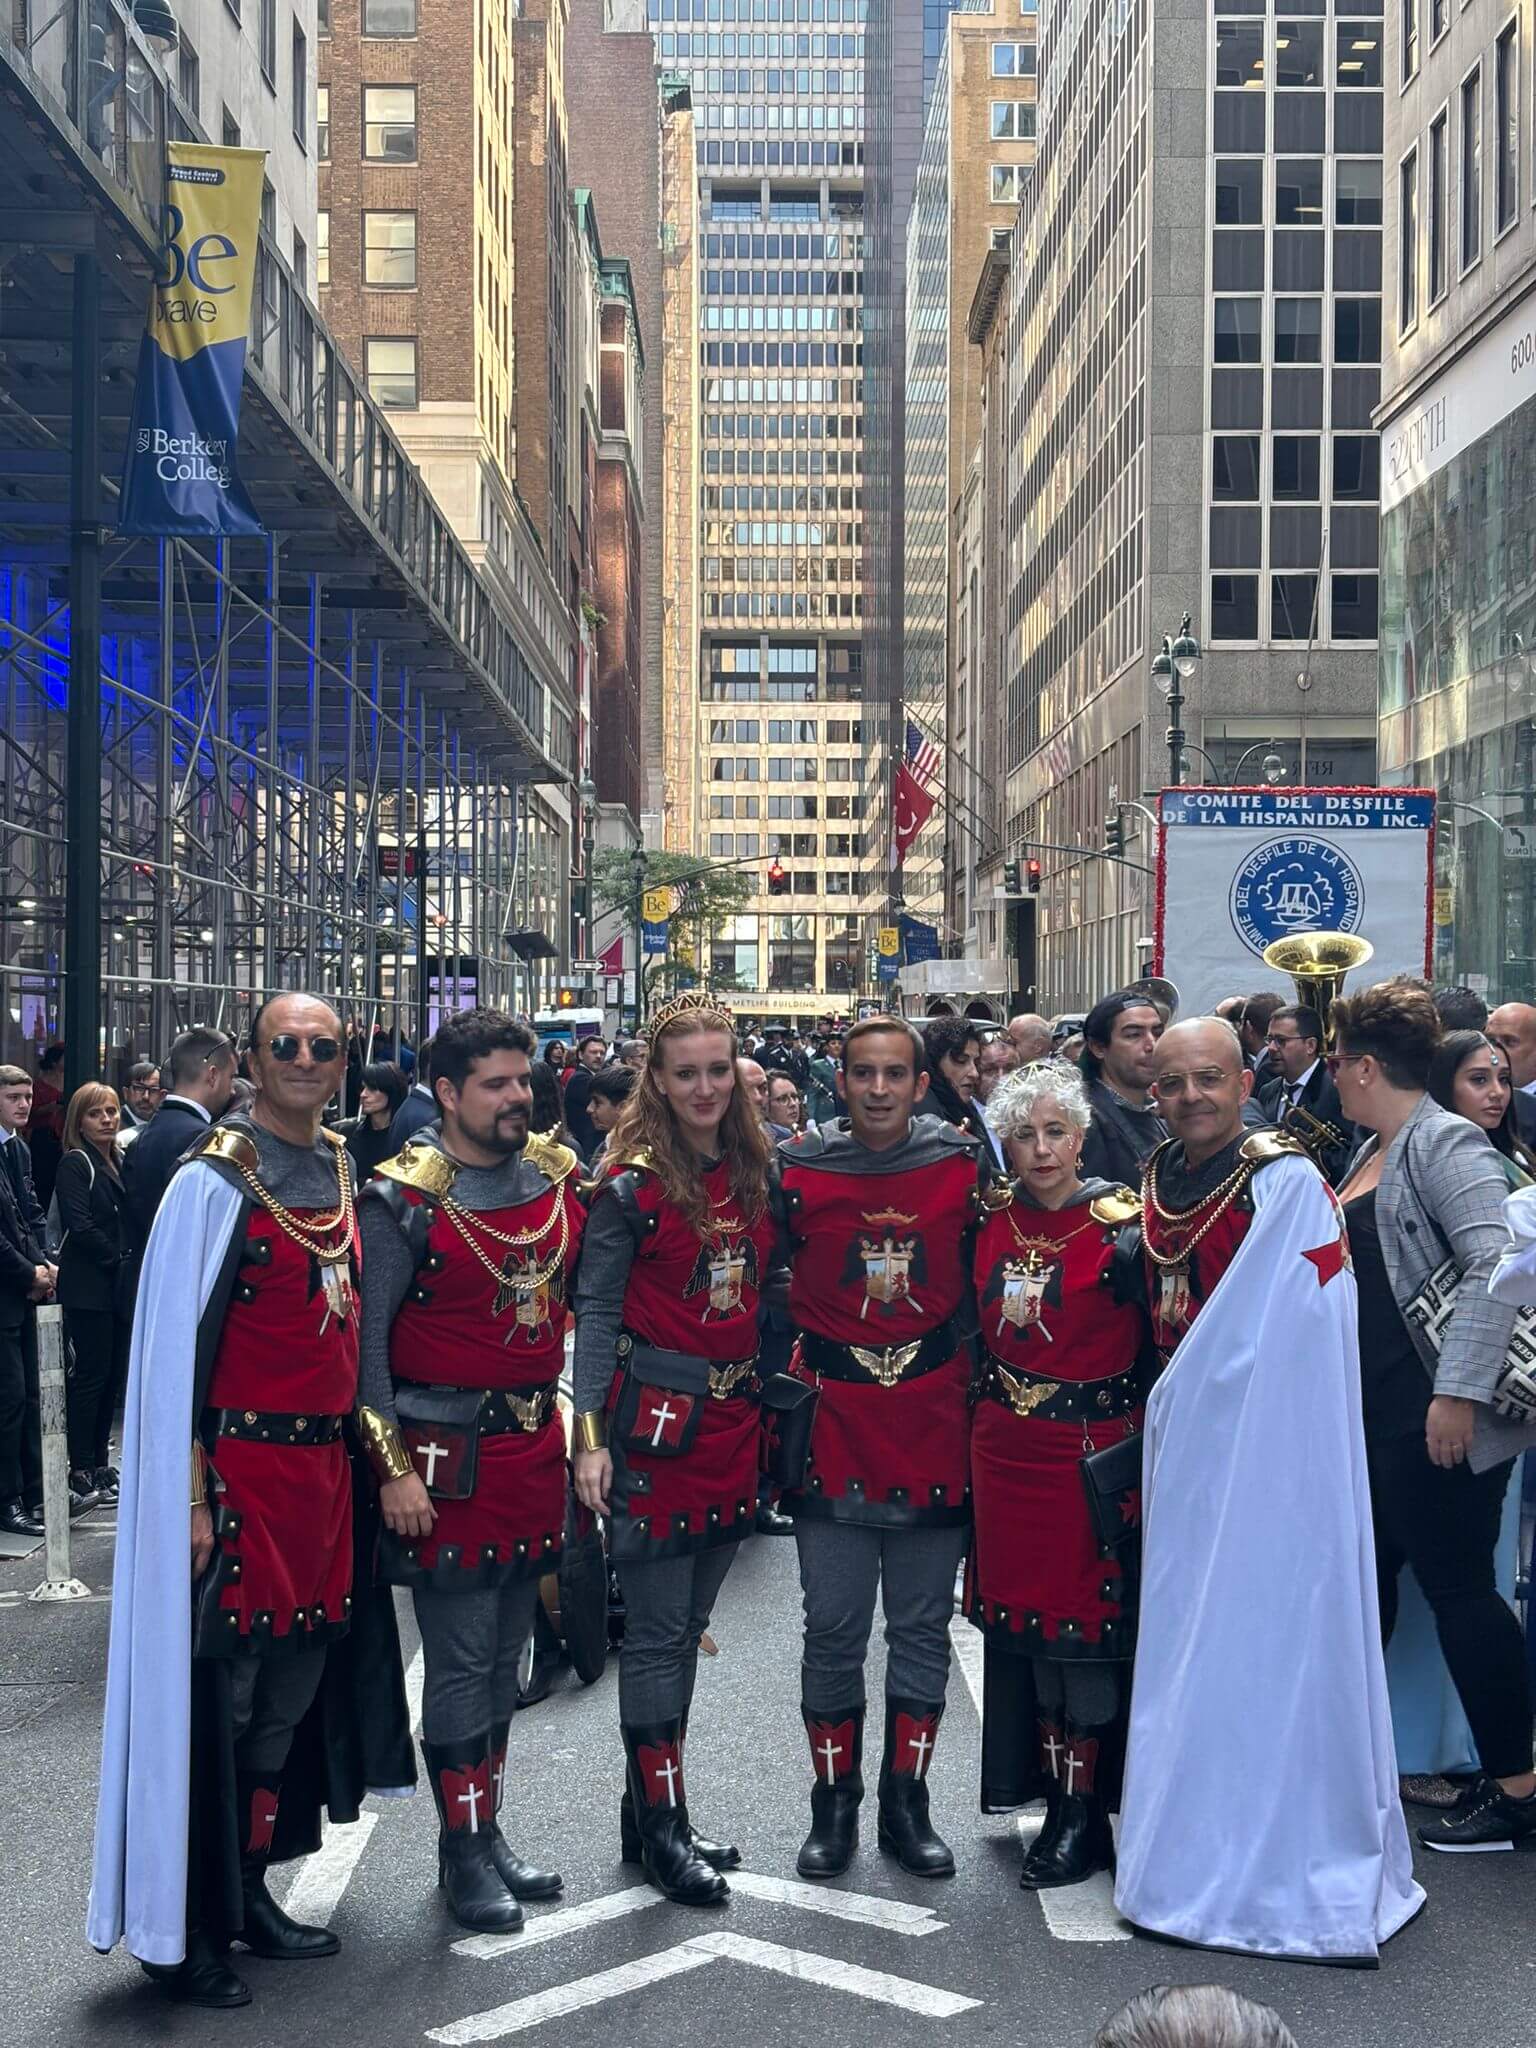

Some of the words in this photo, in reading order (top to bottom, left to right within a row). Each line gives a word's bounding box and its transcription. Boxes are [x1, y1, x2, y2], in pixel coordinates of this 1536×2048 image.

[1511, 332, 1536, 375] 600,
[156, 455, 231, 488] Colleg
[1183, 794, 1262, 808] COMITE
[1275, 796, 1312, 809] DEL
[1326, 796, 1406, 811] DESFILE
[1162, 810, 1187, 824] DE
[1201, 811, 1226, 825] LA
[1240, 812, 1370, 827] HISPANIDAD
[1383, 814, 1426, 828] INC.
[1244, 841, 1293, 879] DESFILE
[1298, 841, 1317, 856] DE
[1320, 848, 1339, 868] LA
[1237, 883, 1251, 908] DEL
[1338, 867, 1358, 932] HISPANID
[1239, 913, 1269, 950] OMITE
[733, 999, 768, 1008] METLIFE
[773, 1000, 816, 1009] BUILDING
